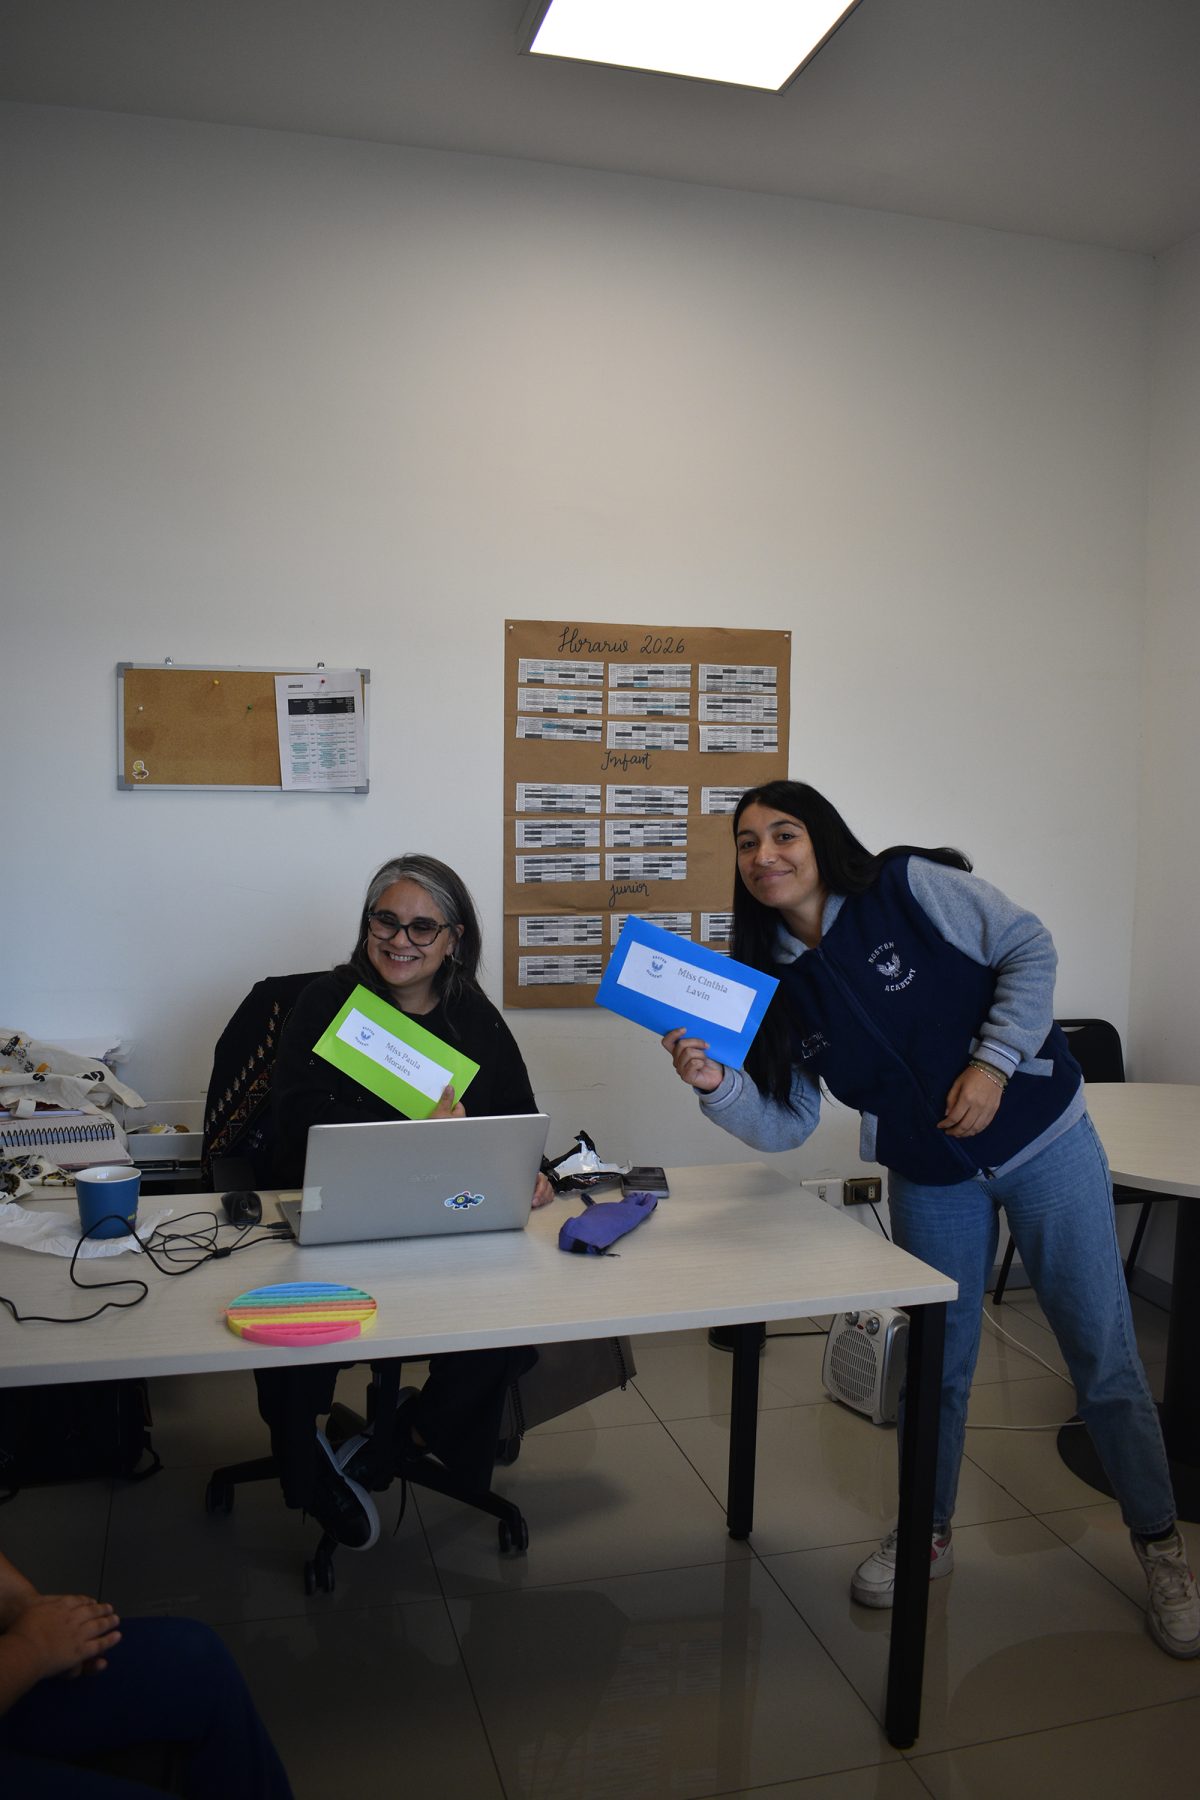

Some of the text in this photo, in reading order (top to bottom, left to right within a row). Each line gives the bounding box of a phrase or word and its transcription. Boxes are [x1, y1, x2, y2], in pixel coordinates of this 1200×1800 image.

[558, 626, 685, 654] Horario 2026
[601, 750, 652, 771] Infant
[868, 941, 895, 964] BOSTON
[678, 967, 697, 981] Miss
[697, 976, 728, 993] Cinthia
[884, 968, 916, 992] ACADEMY
[384, 1054, 411, 1076] Morales
[385, 1042, 421, 1070] Miss Paula
